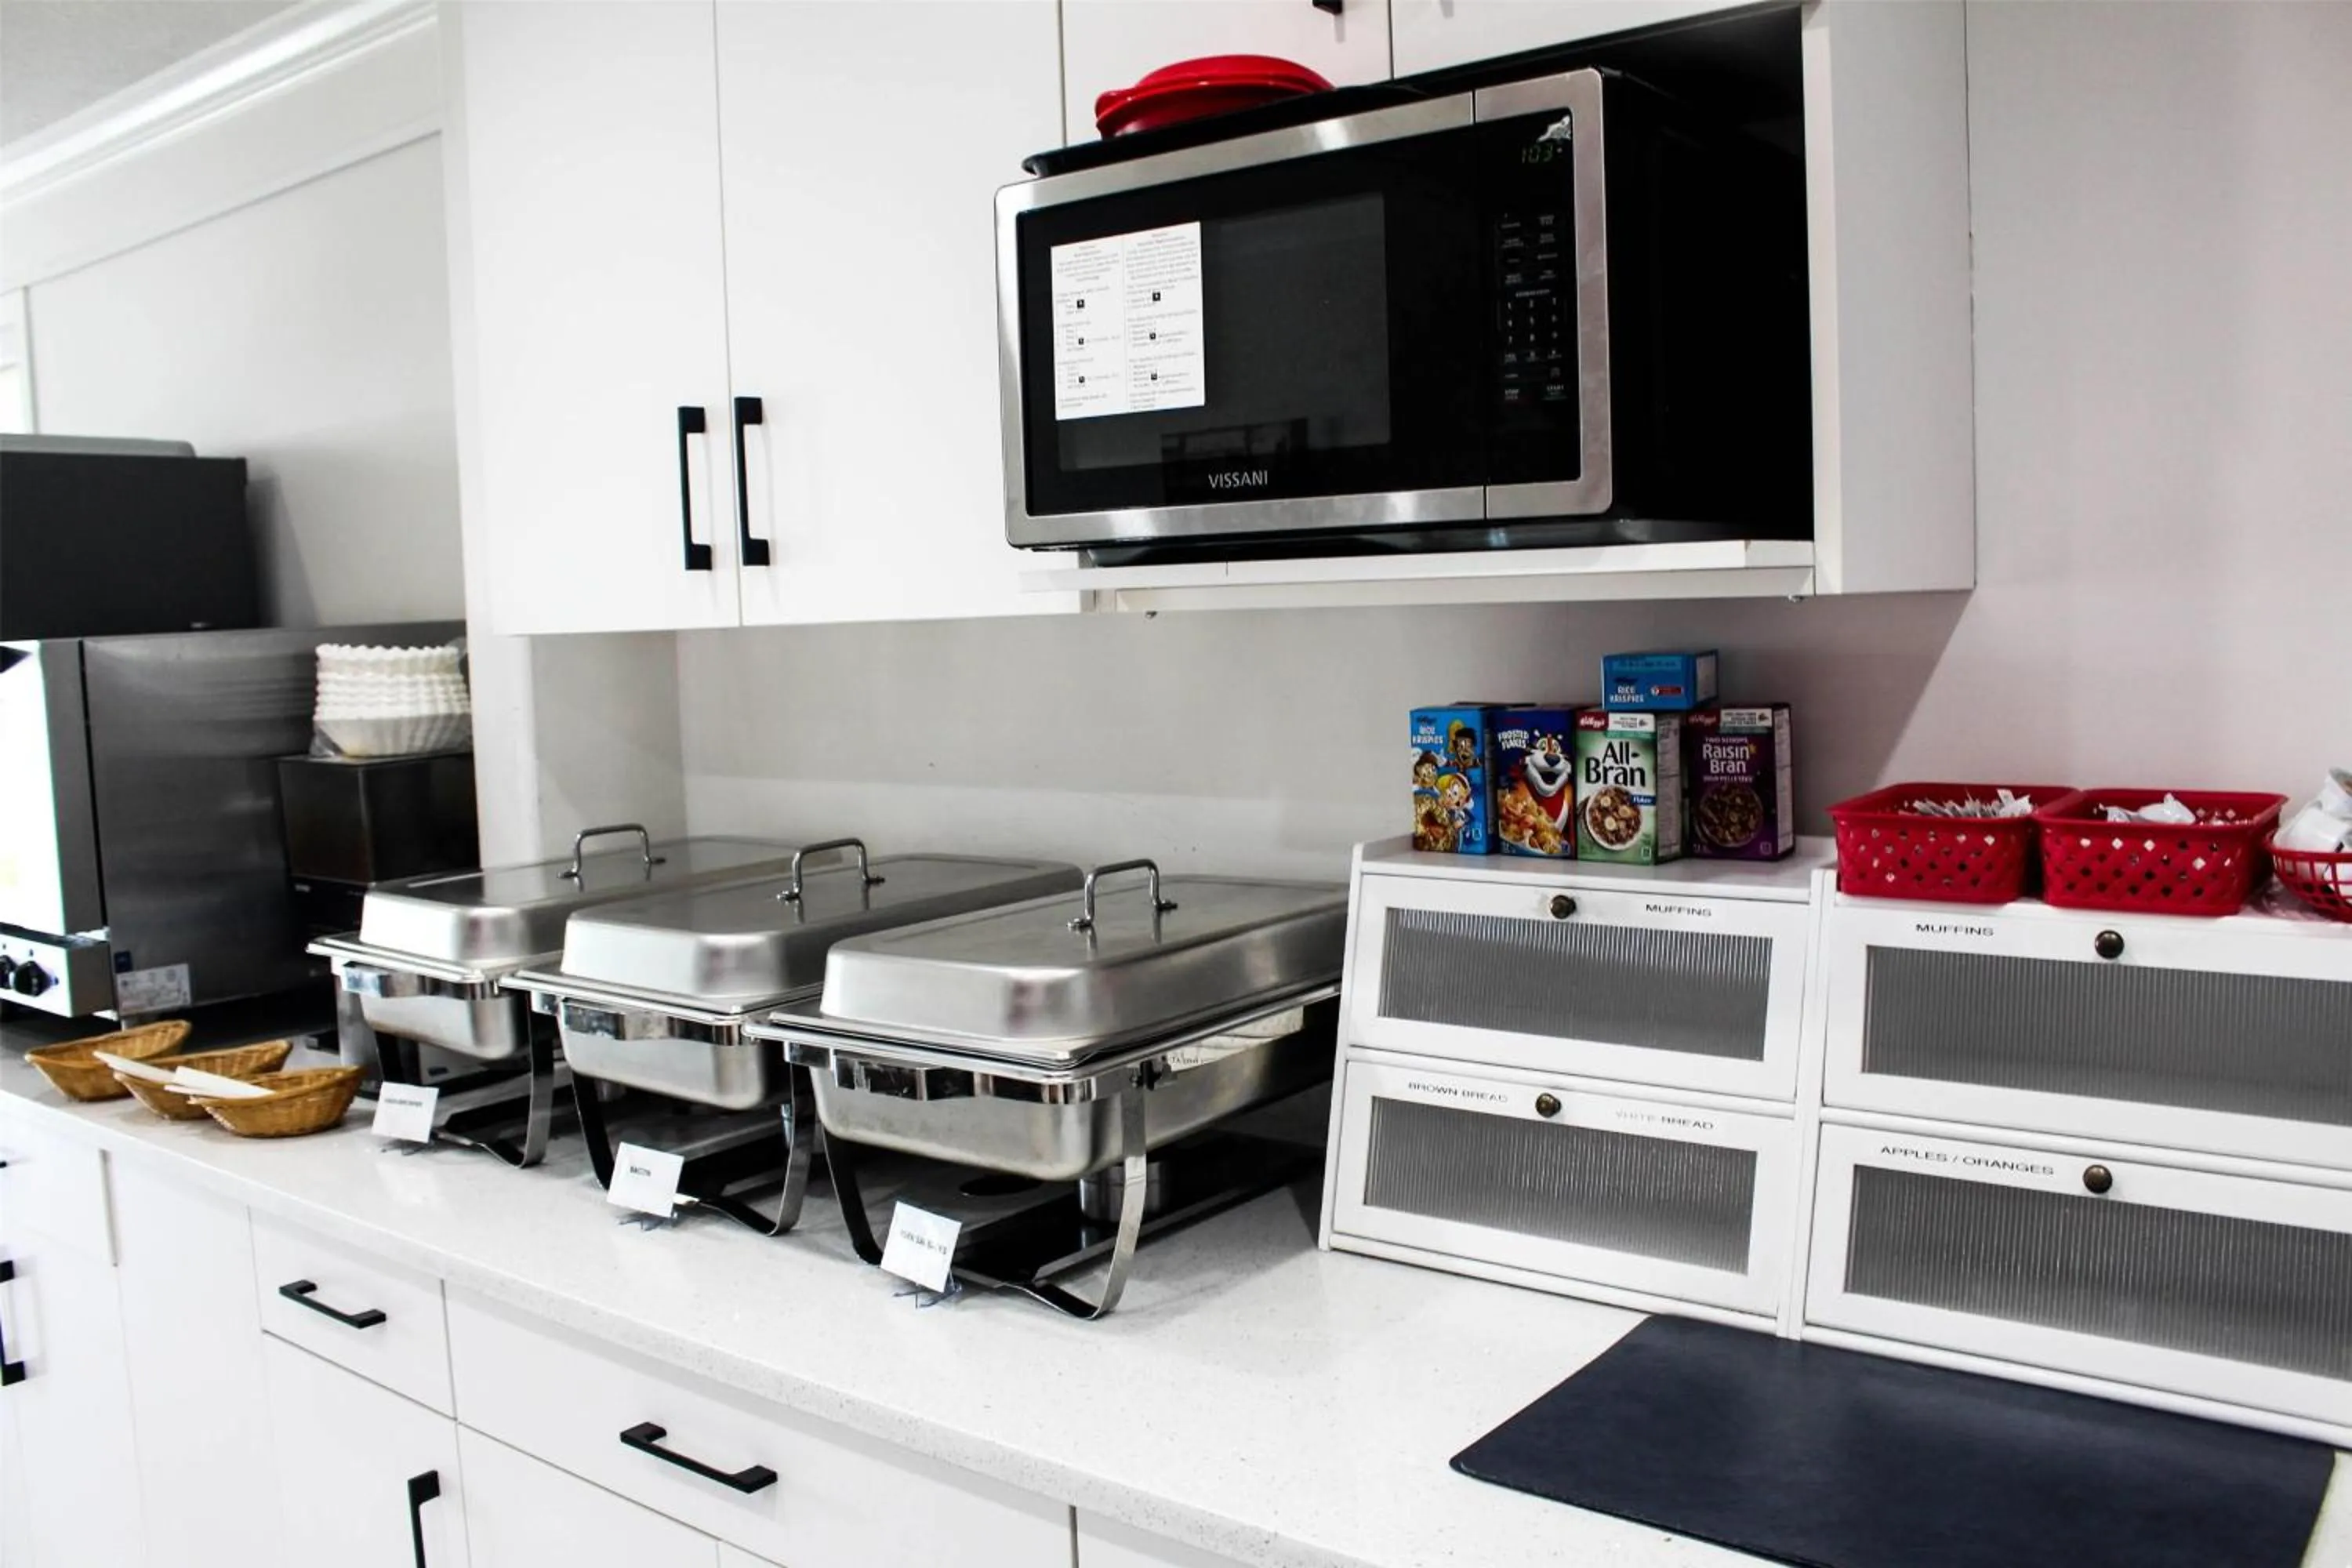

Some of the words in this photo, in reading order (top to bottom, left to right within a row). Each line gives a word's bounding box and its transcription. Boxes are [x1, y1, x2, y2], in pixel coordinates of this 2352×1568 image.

[1208, 470, 1268, 488] VISSANI
[1602, 741, 1639, 765] All-
[1702, 743, 1749, 760] Raisin
[1585, 757, 1646, 787] Bran
[1710, 759, 1747, 774] Bran
[1646, 903, 1712, 916] MUFFINS
[1915, 923, 1994, 937] MUFFINS
[1409, 1081, 1457, 1097] BROWN
[1462, 1089, 1508, 1103] BREAD
[1881, 1145, 1947, 1163] APPLES
[1962, 1155, 2054, 1176] ORANGES
